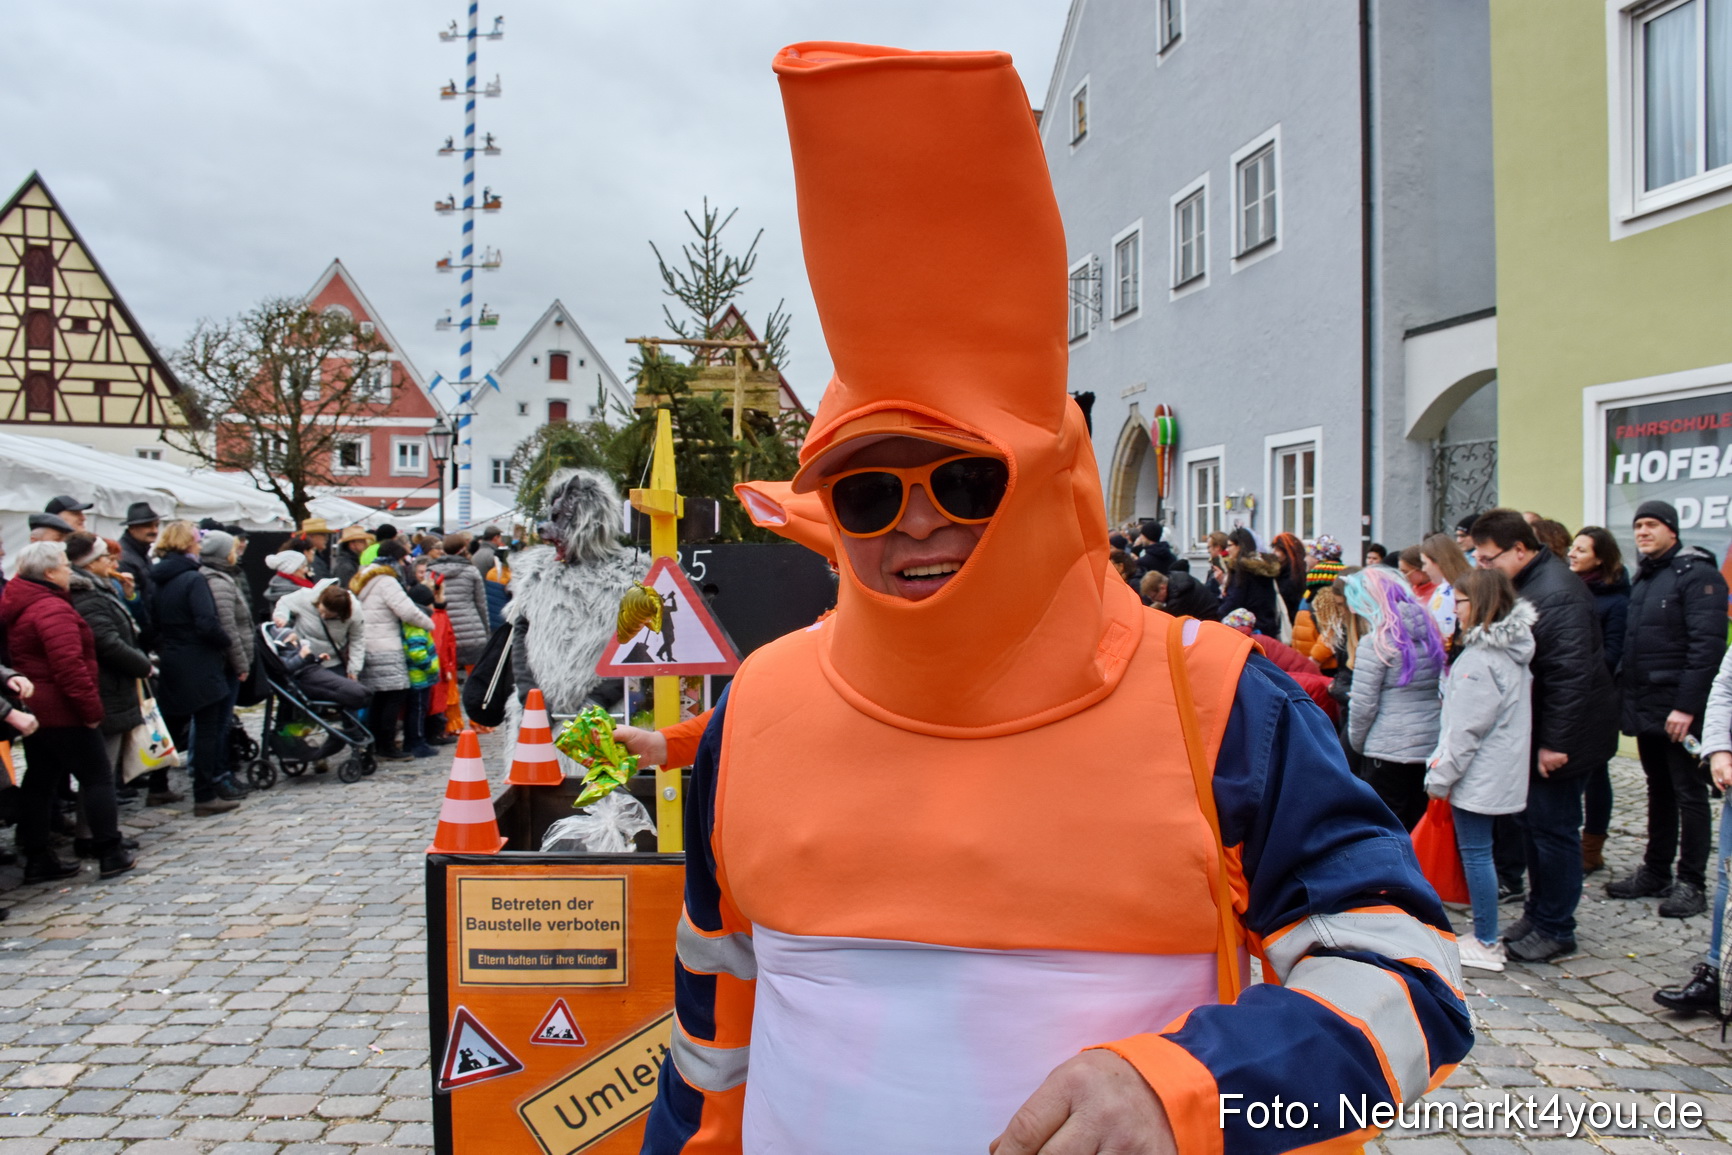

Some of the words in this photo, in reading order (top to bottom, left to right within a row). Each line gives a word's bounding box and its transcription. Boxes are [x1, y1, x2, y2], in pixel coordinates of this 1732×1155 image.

[1615, 411, 1732, 440] FAHRSCHULE
[1614, 444, 1732, 485] HOFBA
[1675, 494, 1732, 530] DE
[491, 897, 561, 911] Betreten
[566, 897, 594, 911] der
[466, 917, 542, 931] Baustelle
[547, 917, 620, 931] verboten
[478, 954, 505, 966] Eltern
[507, 954, 537, 966] haften
[540, 954, 553, 966] für
[556, 954, 574, 966] ihre
[577, 954, 607, 966] Kinder
